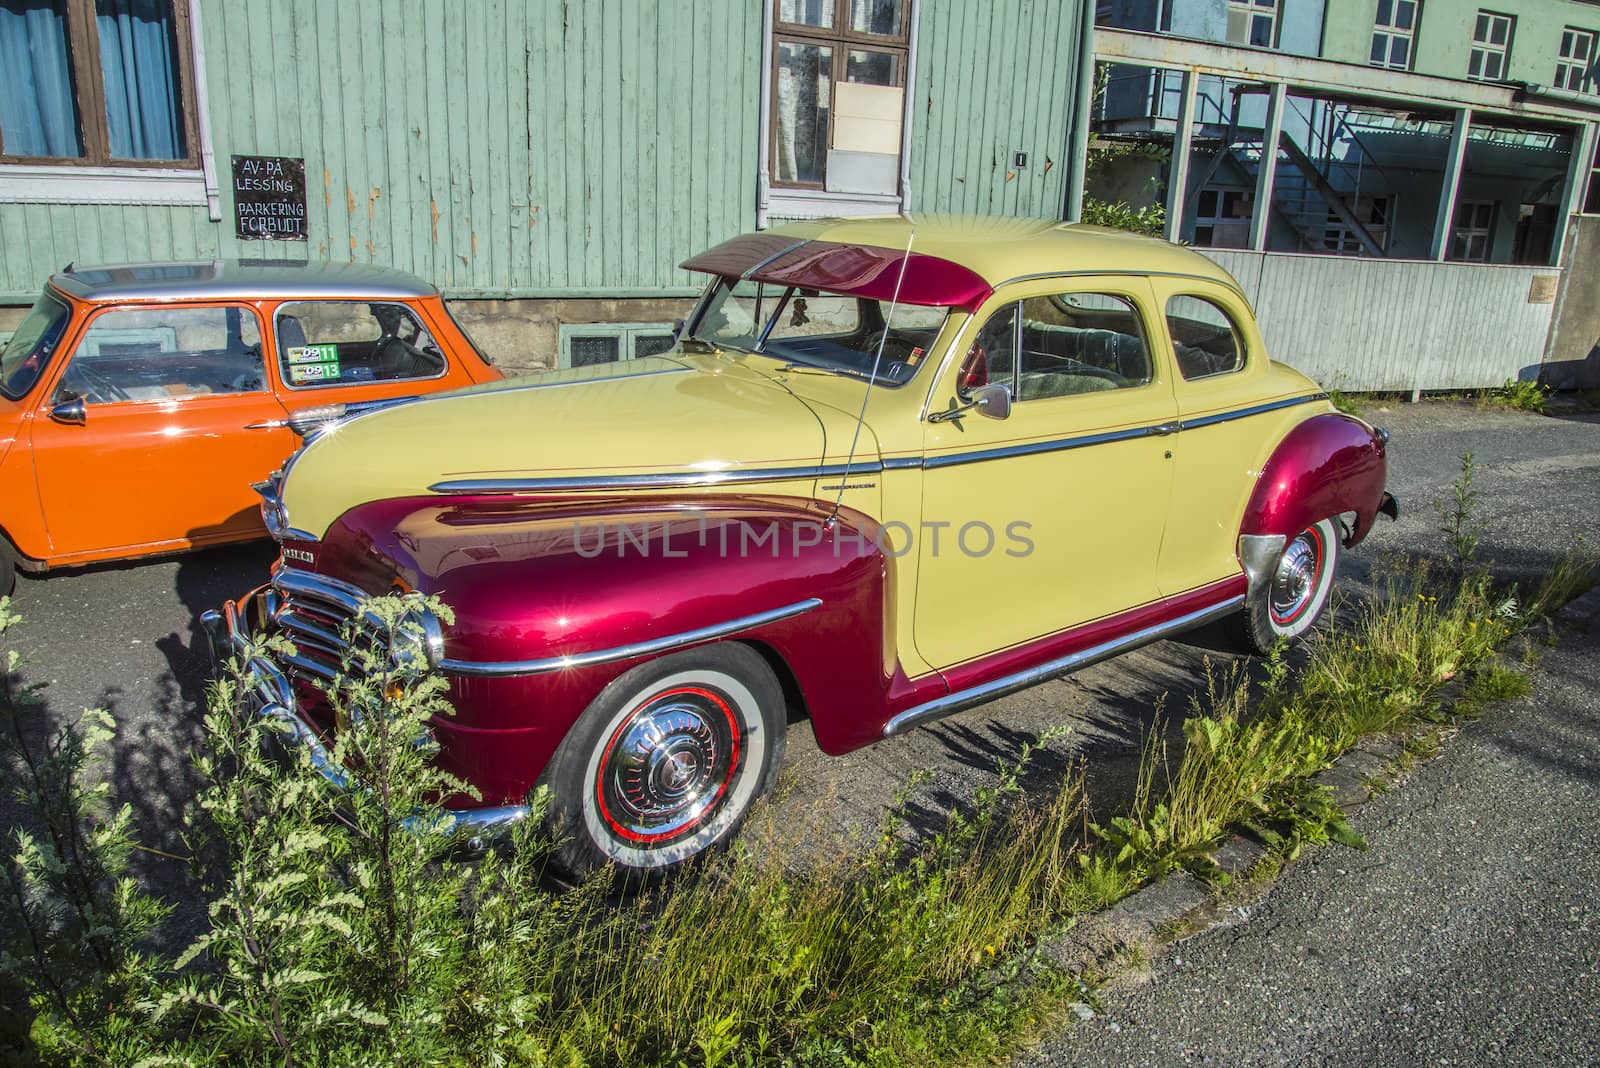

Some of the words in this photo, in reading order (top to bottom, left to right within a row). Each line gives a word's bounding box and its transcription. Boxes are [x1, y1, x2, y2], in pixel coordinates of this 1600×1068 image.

[238, 201, 304, 216] PARKERING
[241, 216, 303, 233] FORBUDT
[320, 347, 335, 360] 11
[323, 364, 338, 377] 13
